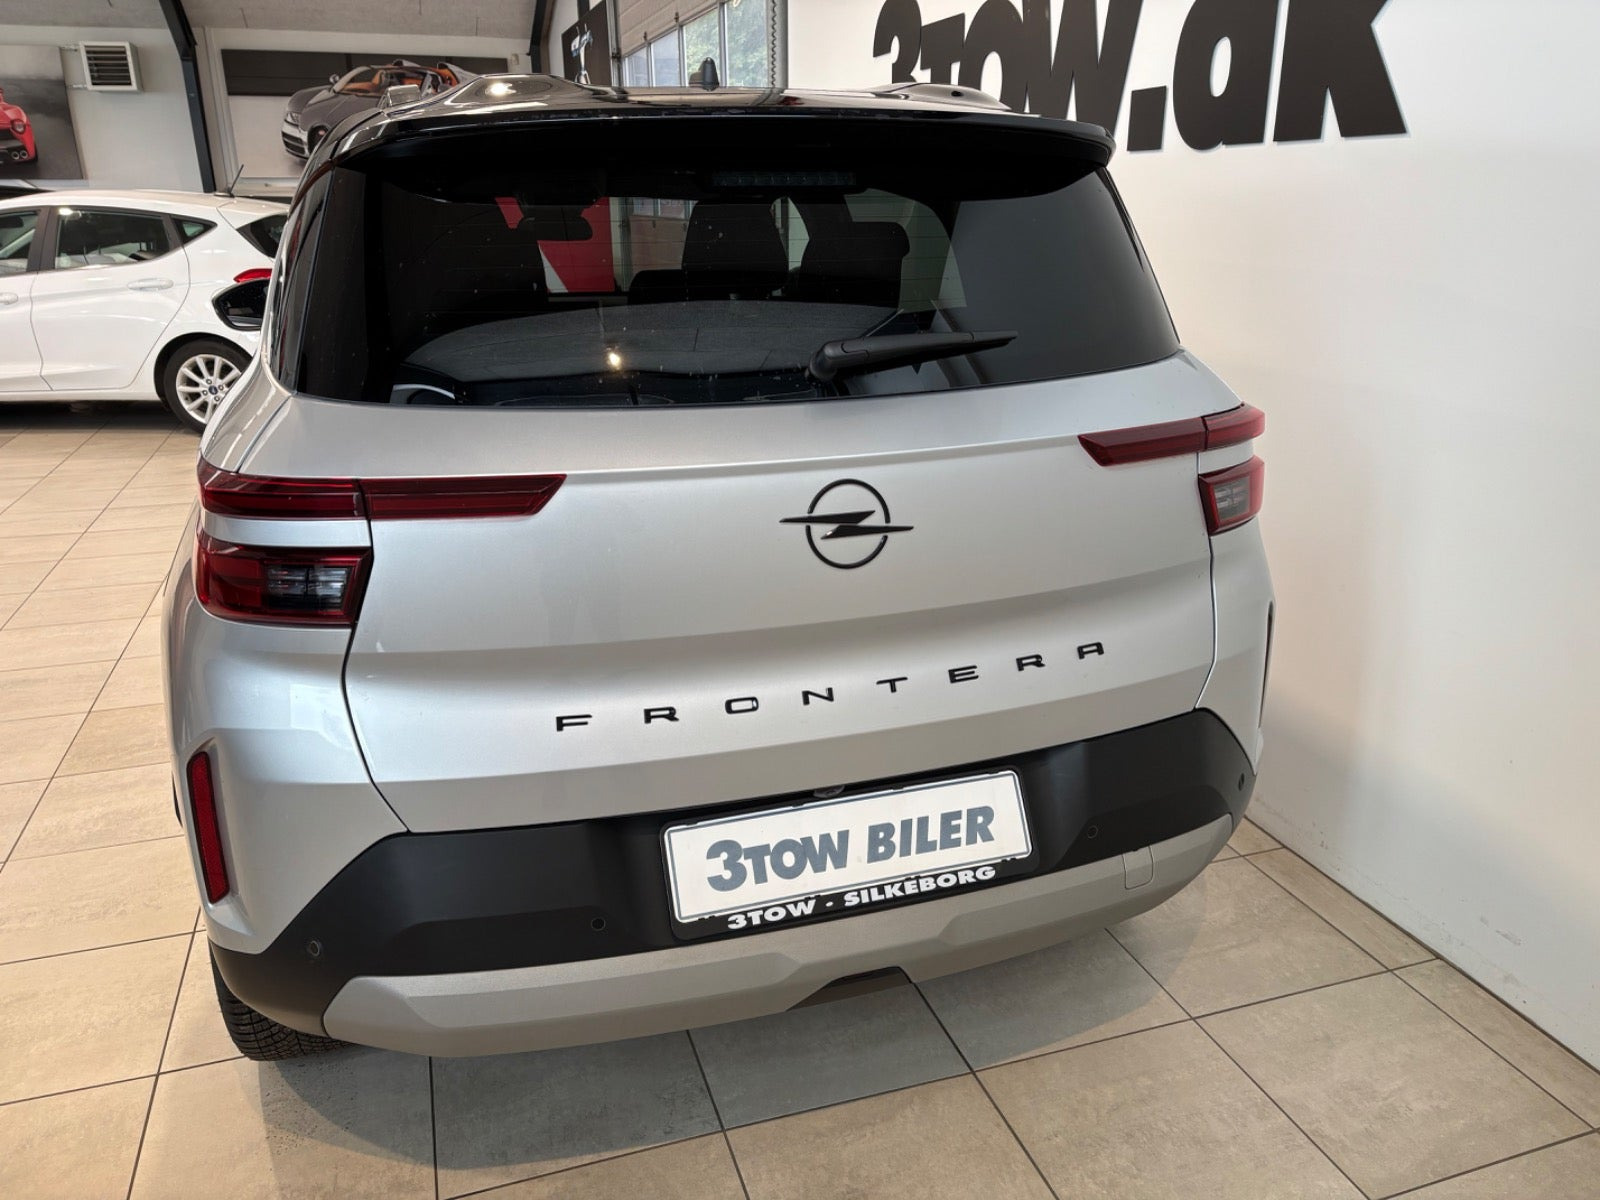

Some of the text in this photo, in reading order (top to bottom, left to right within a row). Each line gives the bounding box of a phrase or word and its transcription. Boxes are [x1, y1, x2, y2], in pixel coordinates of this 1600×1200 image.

[555, 641, 1105, 732] FRONTERA
[706, 805, 995, 892] 3TOW BILER
[727, 899, 816, 930] 3TOW
[843, 866, 996, 908] SILKEBORG
